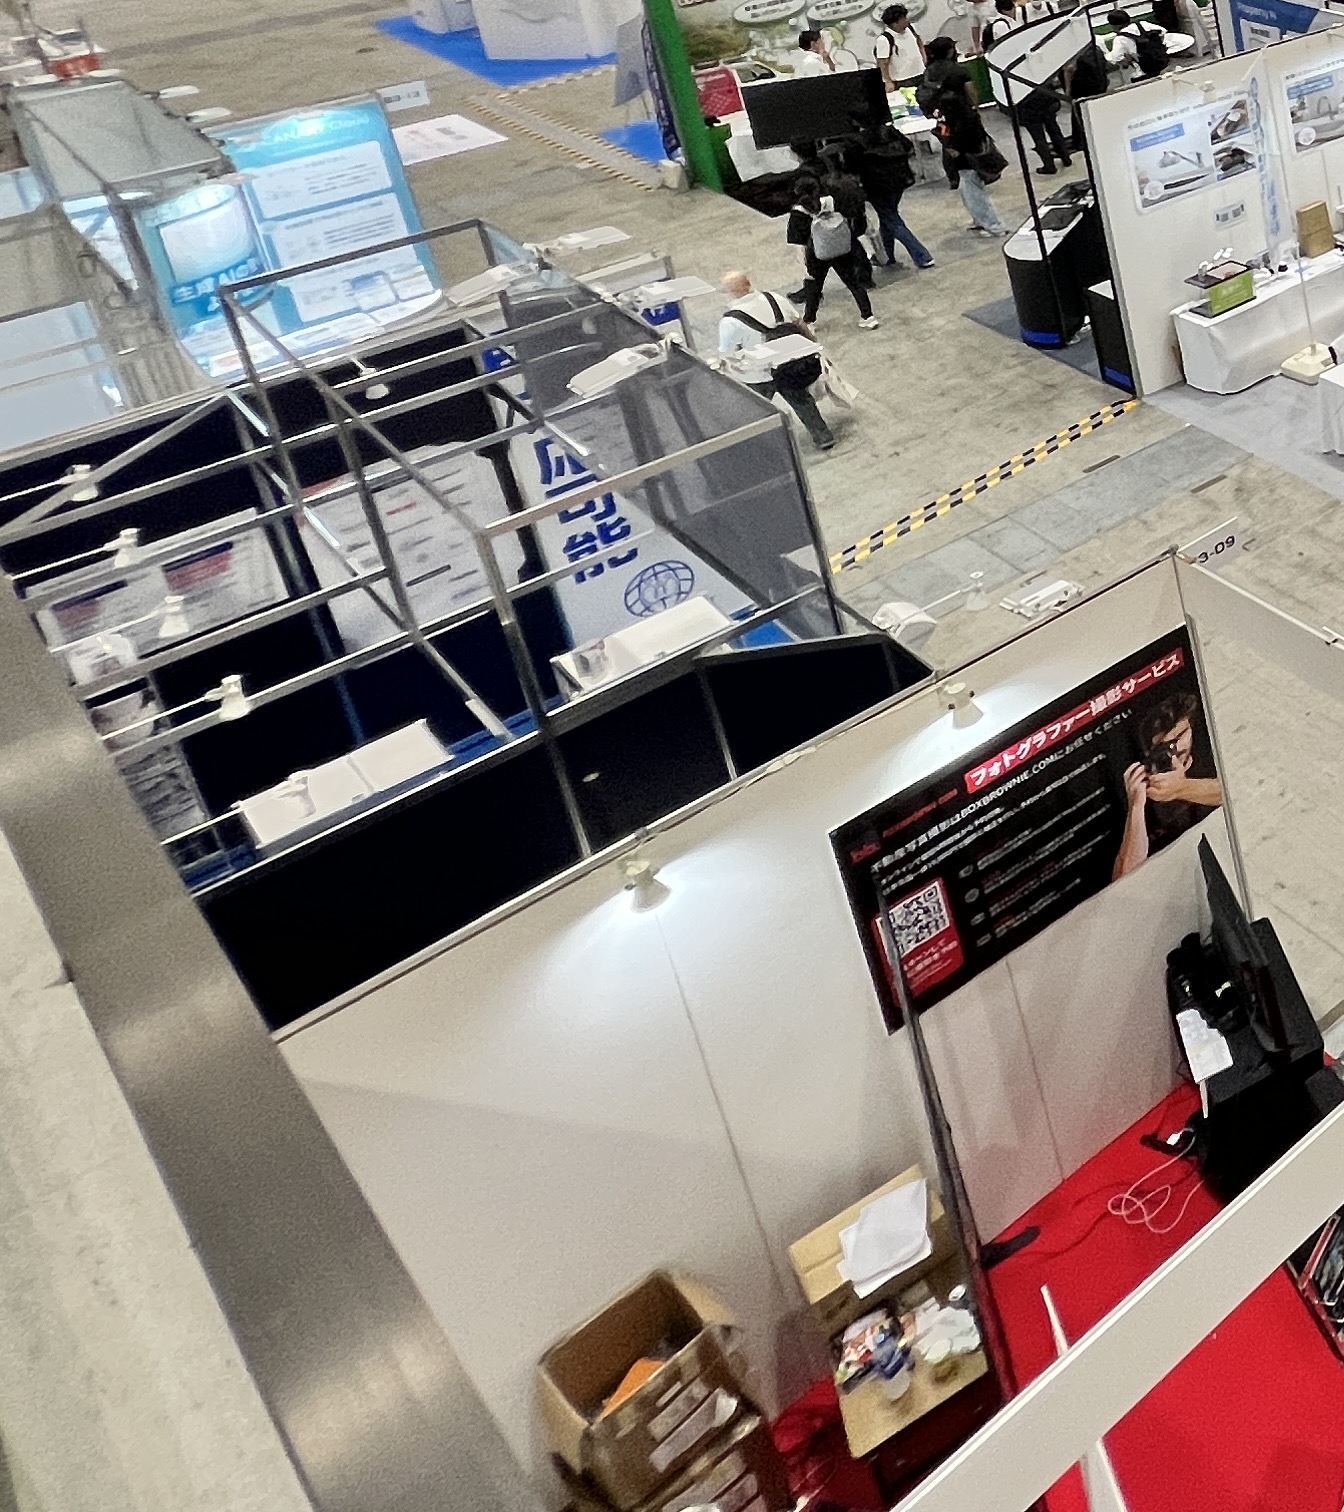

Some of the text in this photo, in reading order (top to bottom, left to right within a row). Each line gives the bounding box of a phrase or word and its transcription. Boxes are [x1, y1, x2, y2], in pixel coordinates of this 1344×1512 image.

[1198, 535, 1236, 564] 3-09
[969, 653, 1181, 786] フォトグラファー撮影サービス
